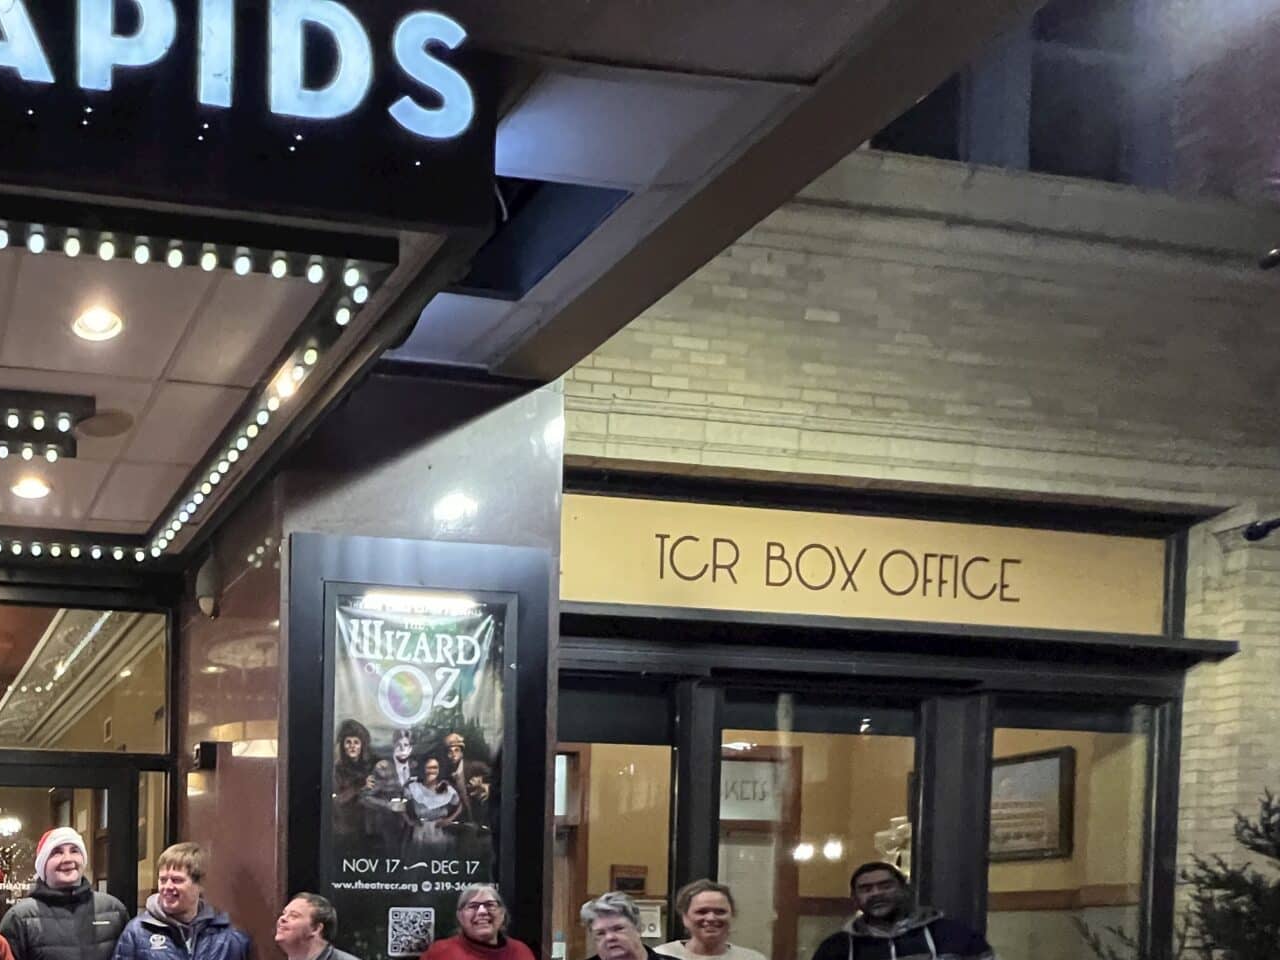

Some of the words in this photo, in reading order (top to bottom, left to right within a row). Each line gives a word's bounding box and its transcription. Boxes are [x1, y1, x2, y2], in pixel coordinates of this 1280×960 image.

[655, 534, 740, 584] TCR
[766, 542, 867, 592] BOX
[880, 549, 1022, 602] OFFICE
[349, 619, 481, 666] WIZARD
[378, 664, 461, 725] OZ
[342, 858, 379, 873] NOV
[386, 859, 401, 873] 17
[431, 860, 460, 874] DEC
[465, 861, 480, 874] 17
